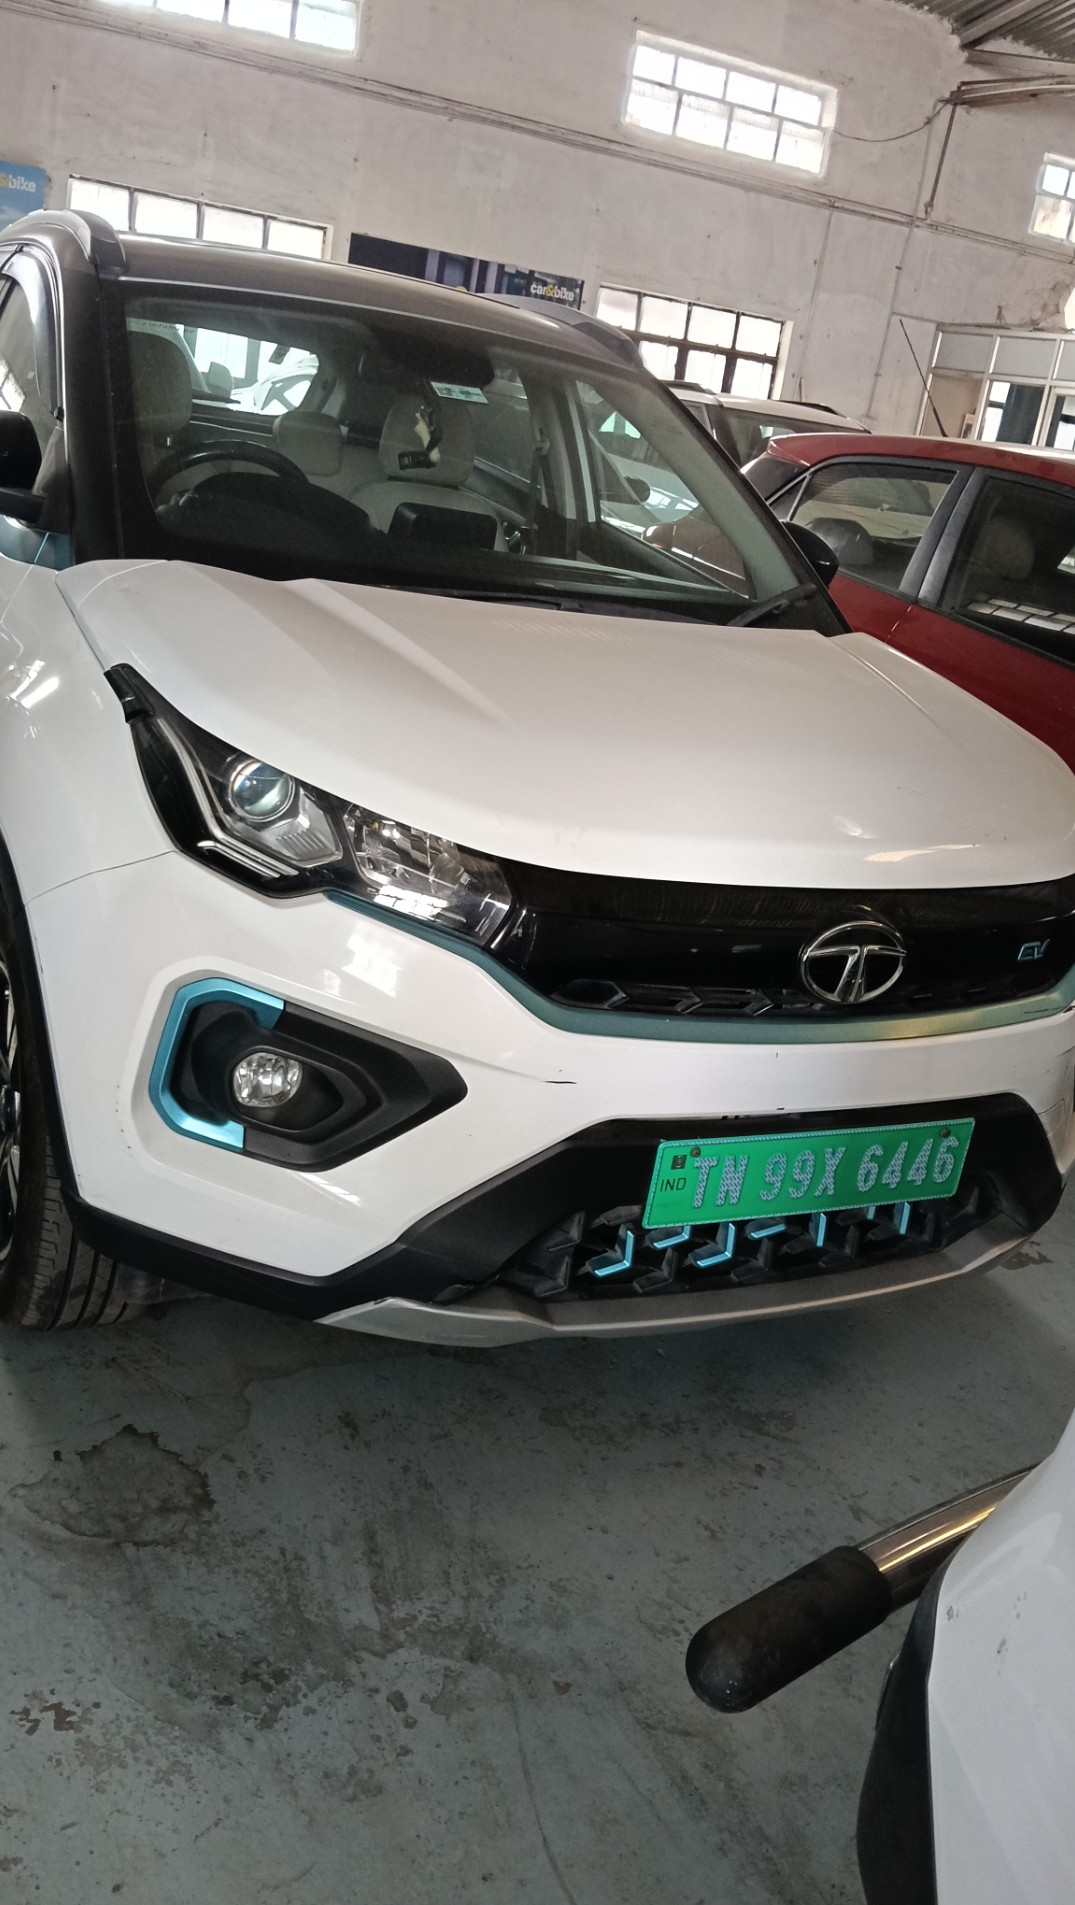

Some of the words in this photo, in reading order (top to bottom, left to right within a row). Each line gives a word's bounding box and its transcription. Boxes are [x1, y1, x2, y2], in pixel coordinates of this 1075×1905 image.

[530, 283, 575, 301] car&bike
[1017, 938, 1051, 961] EV
[692, 1154, 749, 1209] TN
[759, 1146, 847, 1202] 99X
[857, 1136, 960, 1193] 6446
[659, 1177, 687, 1192] IND
